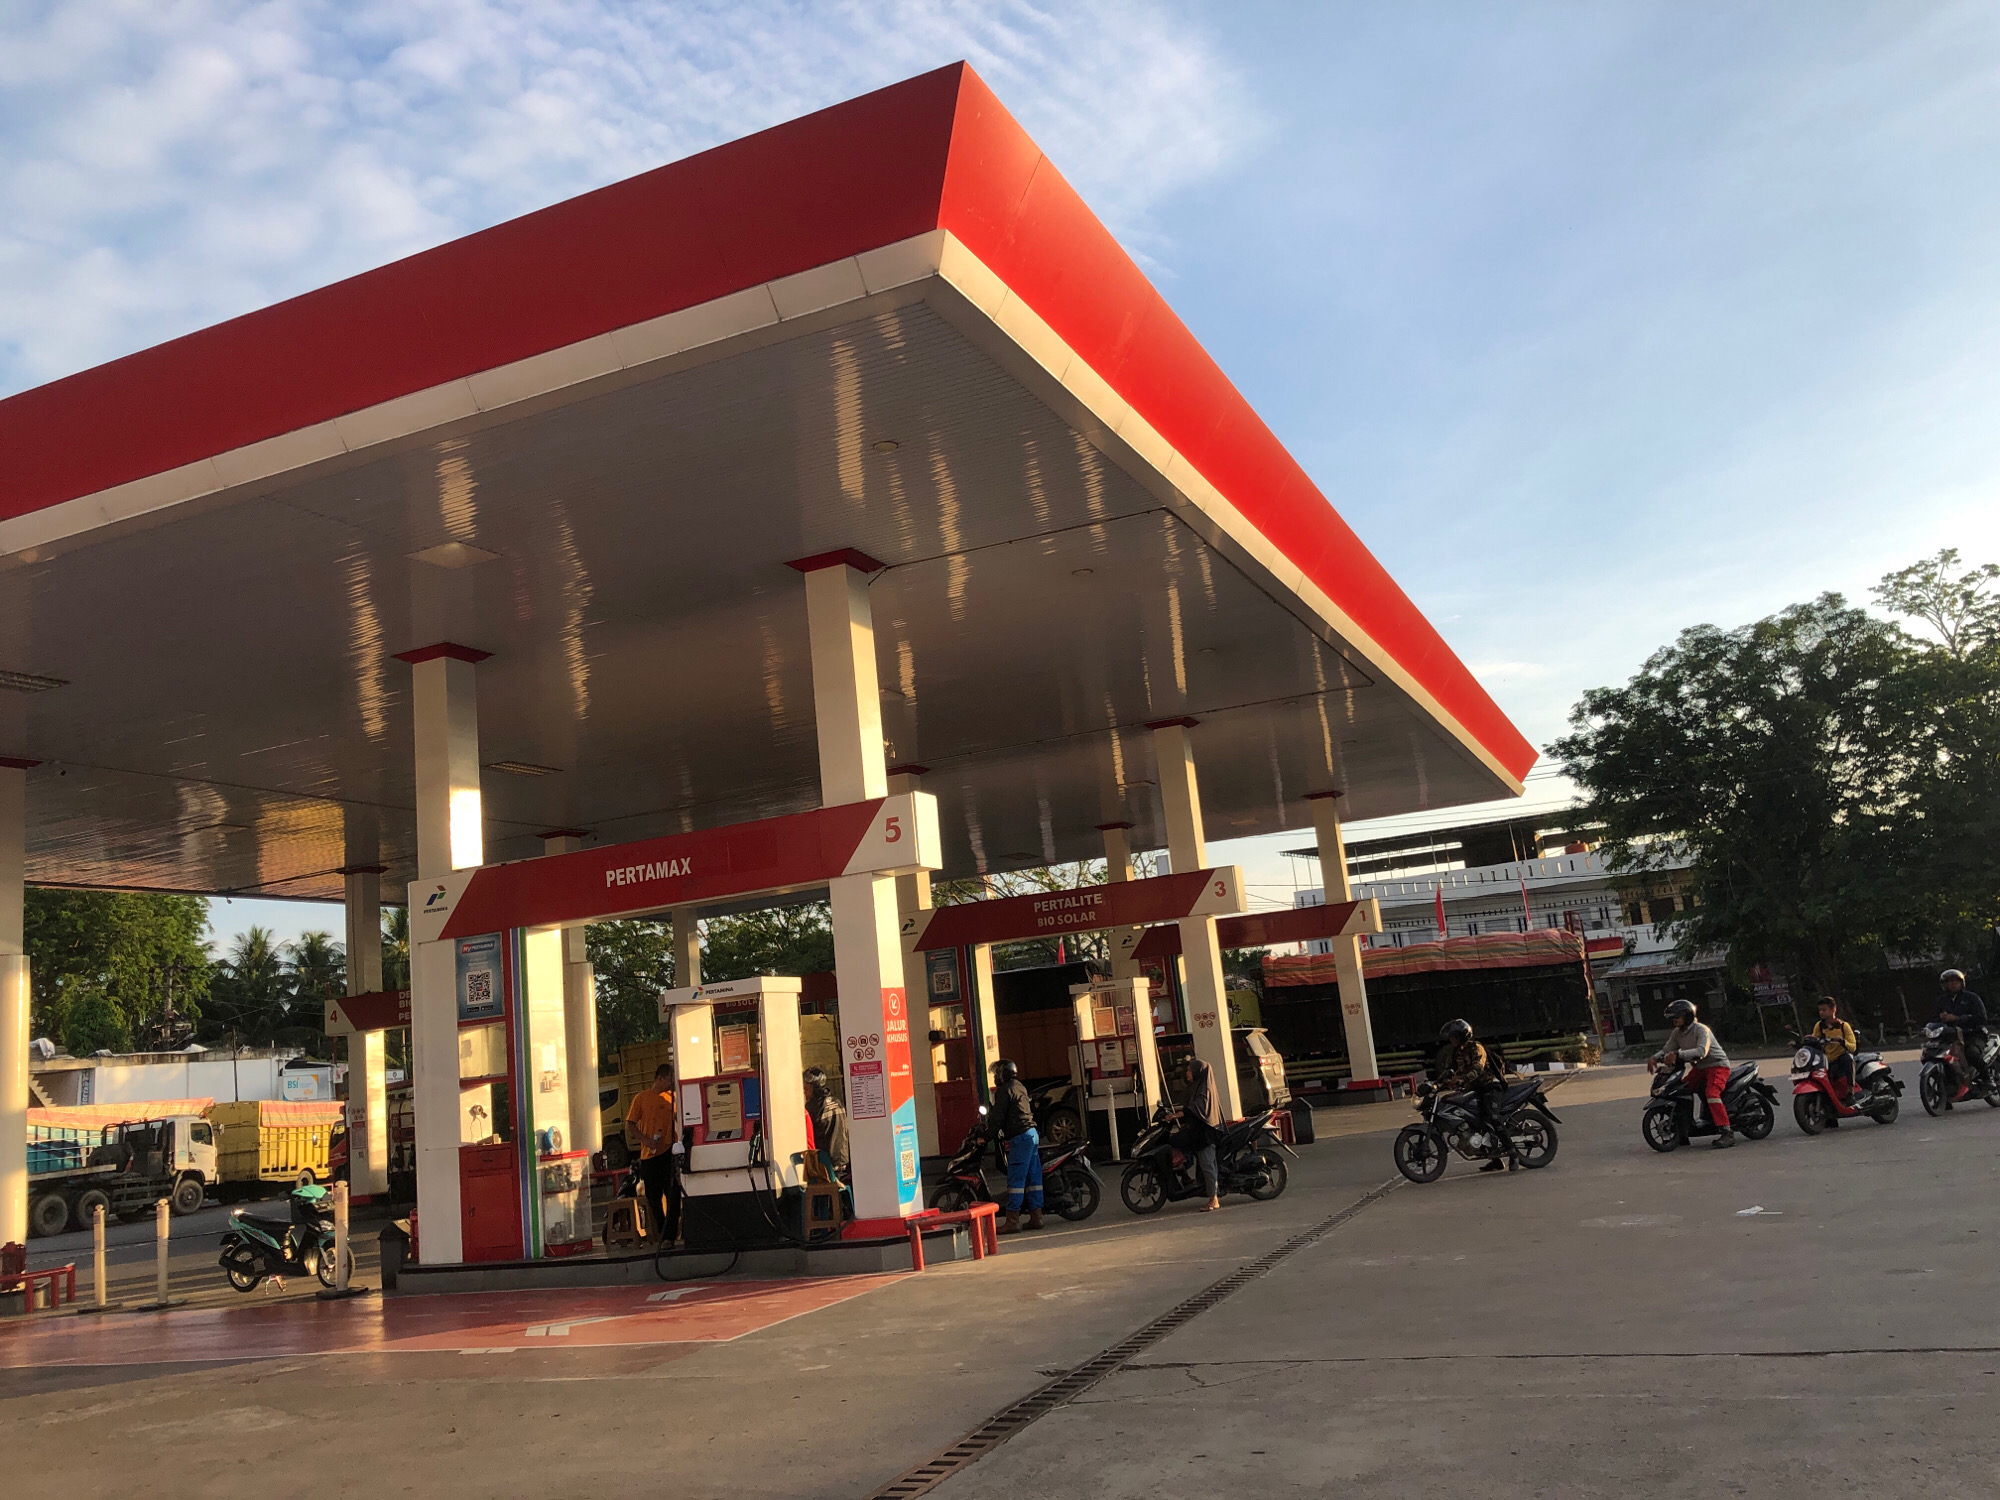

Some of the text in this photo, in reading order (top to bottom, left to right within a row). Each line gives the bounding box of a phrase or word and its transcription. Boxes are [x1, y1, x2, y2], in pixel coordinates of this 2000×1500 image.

[886, 816, 902, 843] 5
[605, 857, 692, 888] PERTAMAX
[1214, 880, 1227, 897] 3
[1034, 893, 1103, 913] PERTALITE
[1037, 910, 1097, 928] BIO SOLAR
[1359, 910, 1366, 921] 1
[705, 986, 734, 995] PERTAMINA
[737, 999, 758, 1007] SOLA
[330, 1010, 338, 1023] 4
[399, 1012, 412, 1021] PE
[886, 1019, 907, 1032] JALUR
[887, 1033, 908, 1043] KHUSUS
[287, 1077, 299, 1089] BSI
